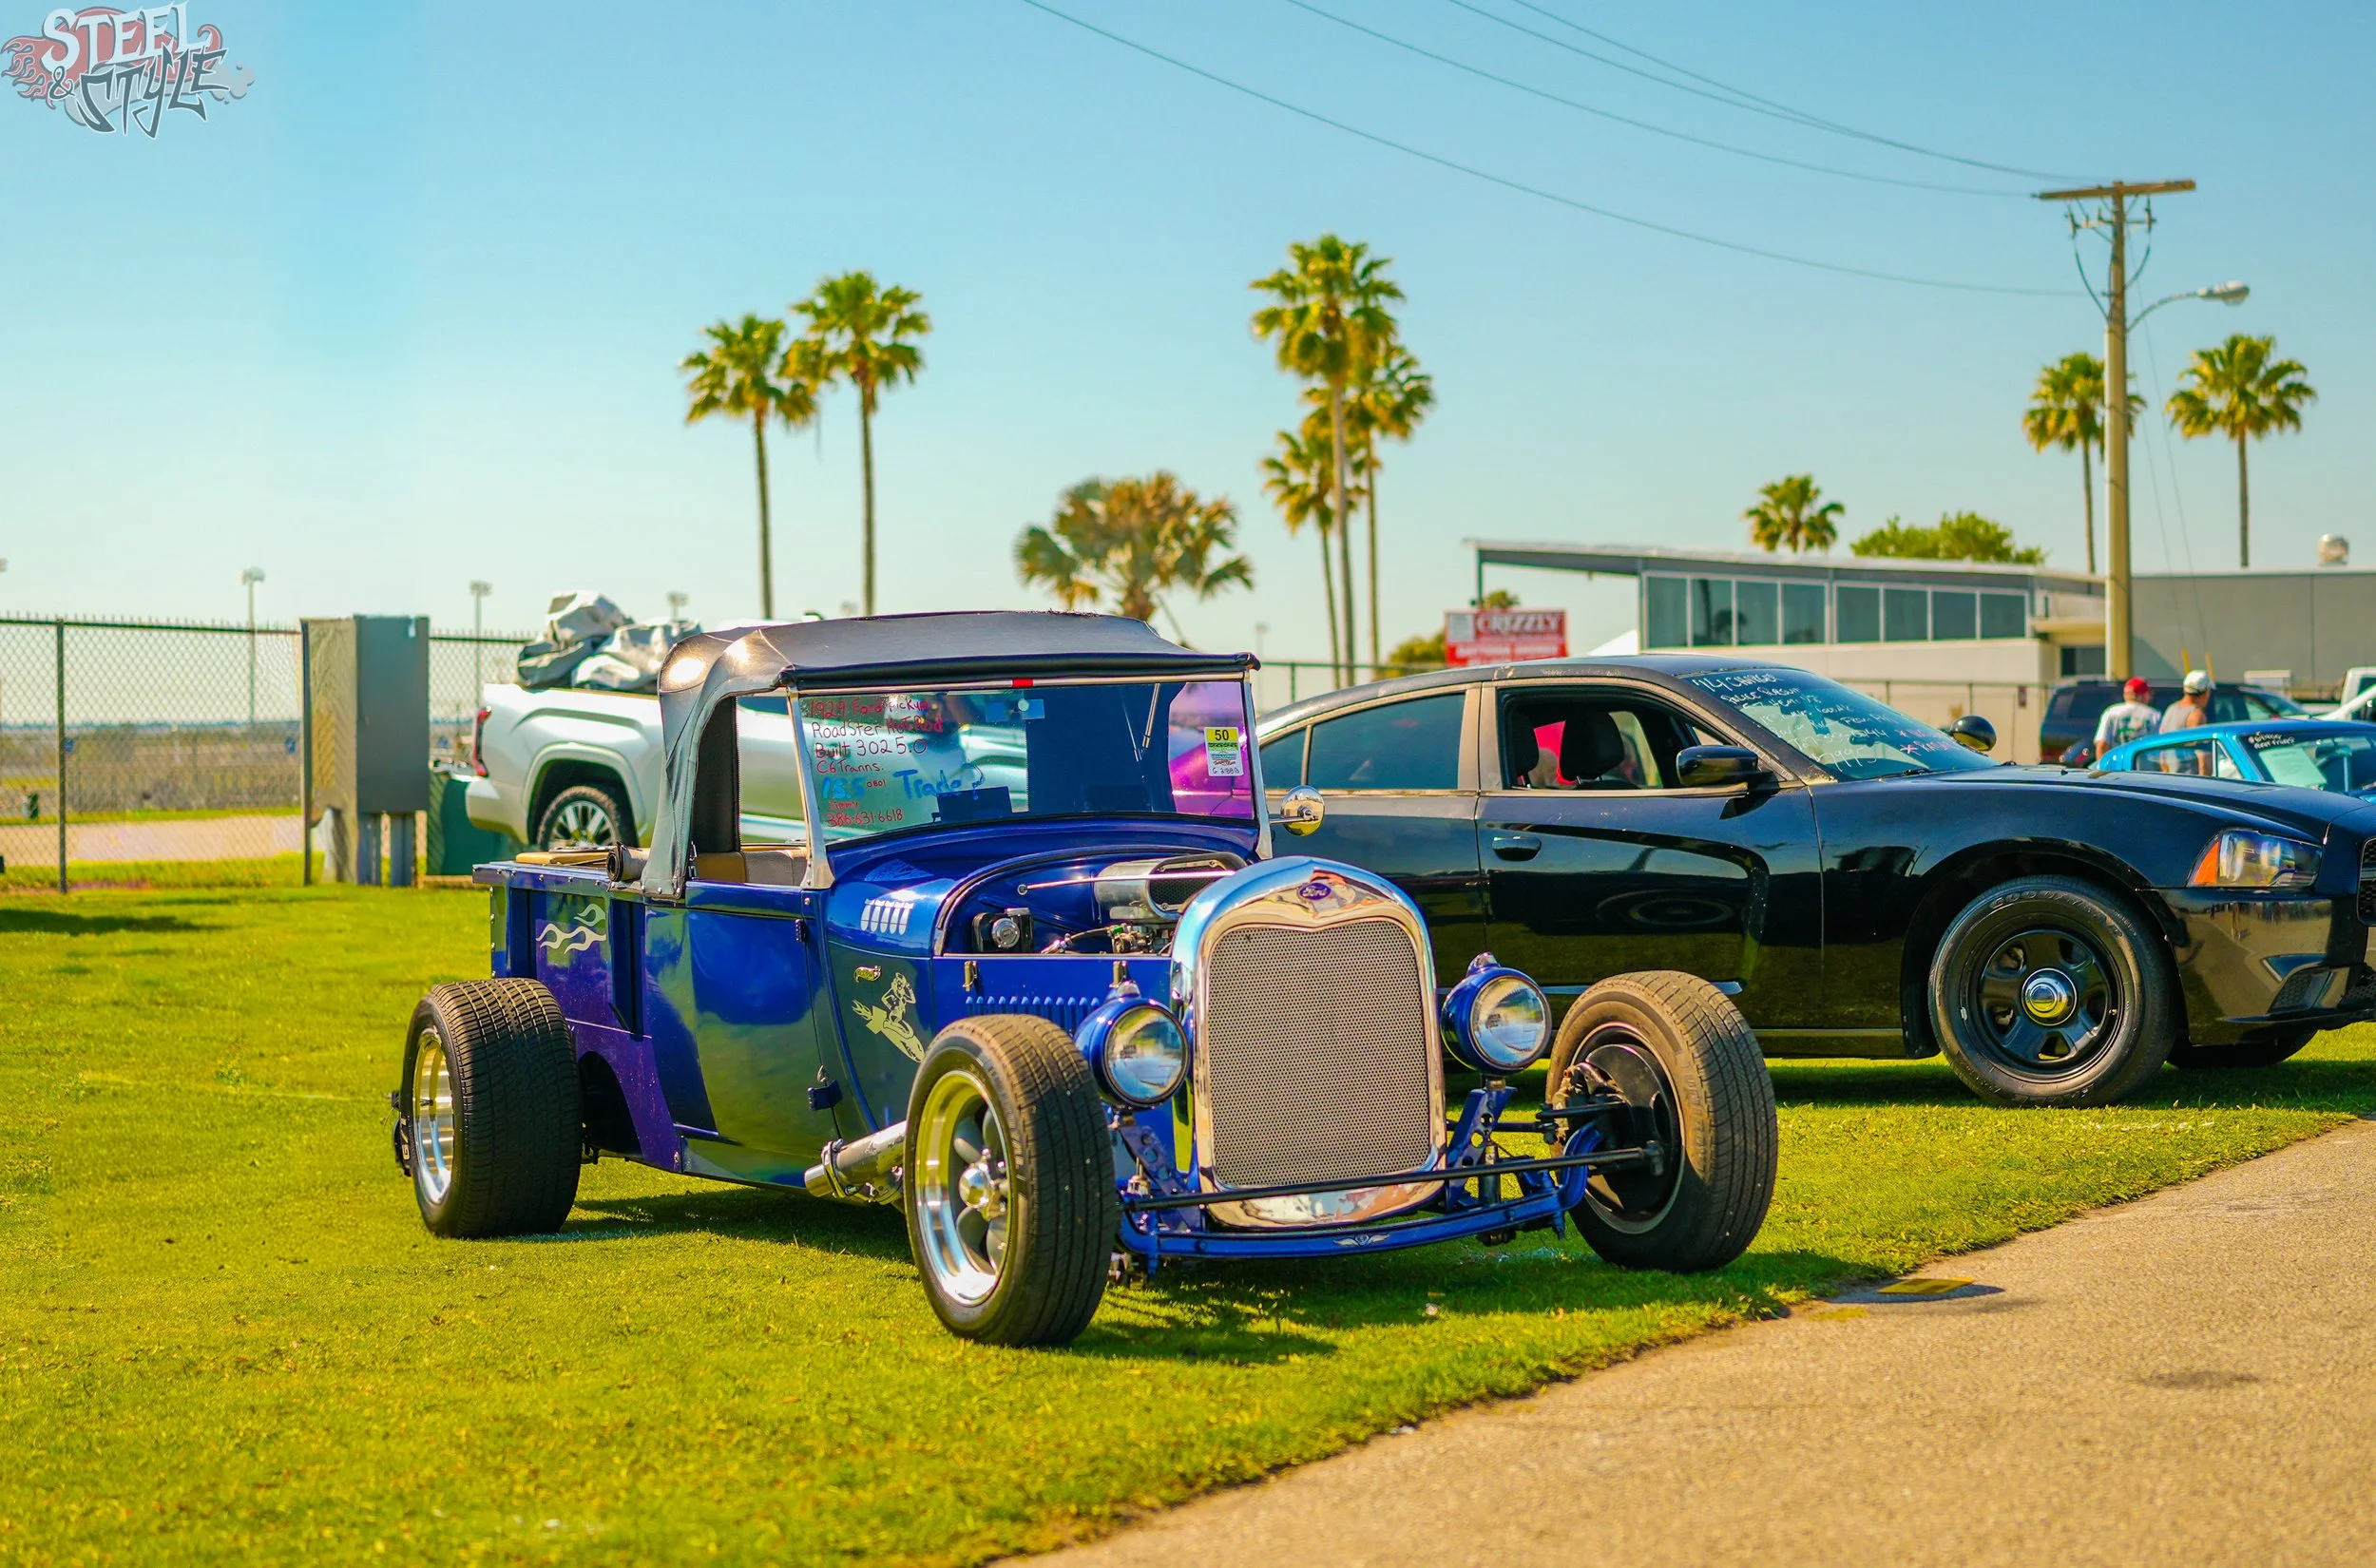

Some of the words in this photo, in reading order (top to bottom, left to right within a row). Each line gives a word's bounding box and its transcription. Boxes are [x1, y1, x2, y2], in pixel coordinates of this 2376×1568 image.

[1477, 613, 1561, 634] GRIZZLY
[810, 698, 848, 719] 1929
[852, 697, 886, 716] Ford
[1215, 729, 1230, 741] 50
[814, 741, 851, 759] Built
[856, 738, 892, 757] 302
[895, 736, 928, 755] 5.0
[816, 759, 837, 774] C6
[892, 769, 962, 800] Trade
[1302, 885, 1329, 897] Ford
